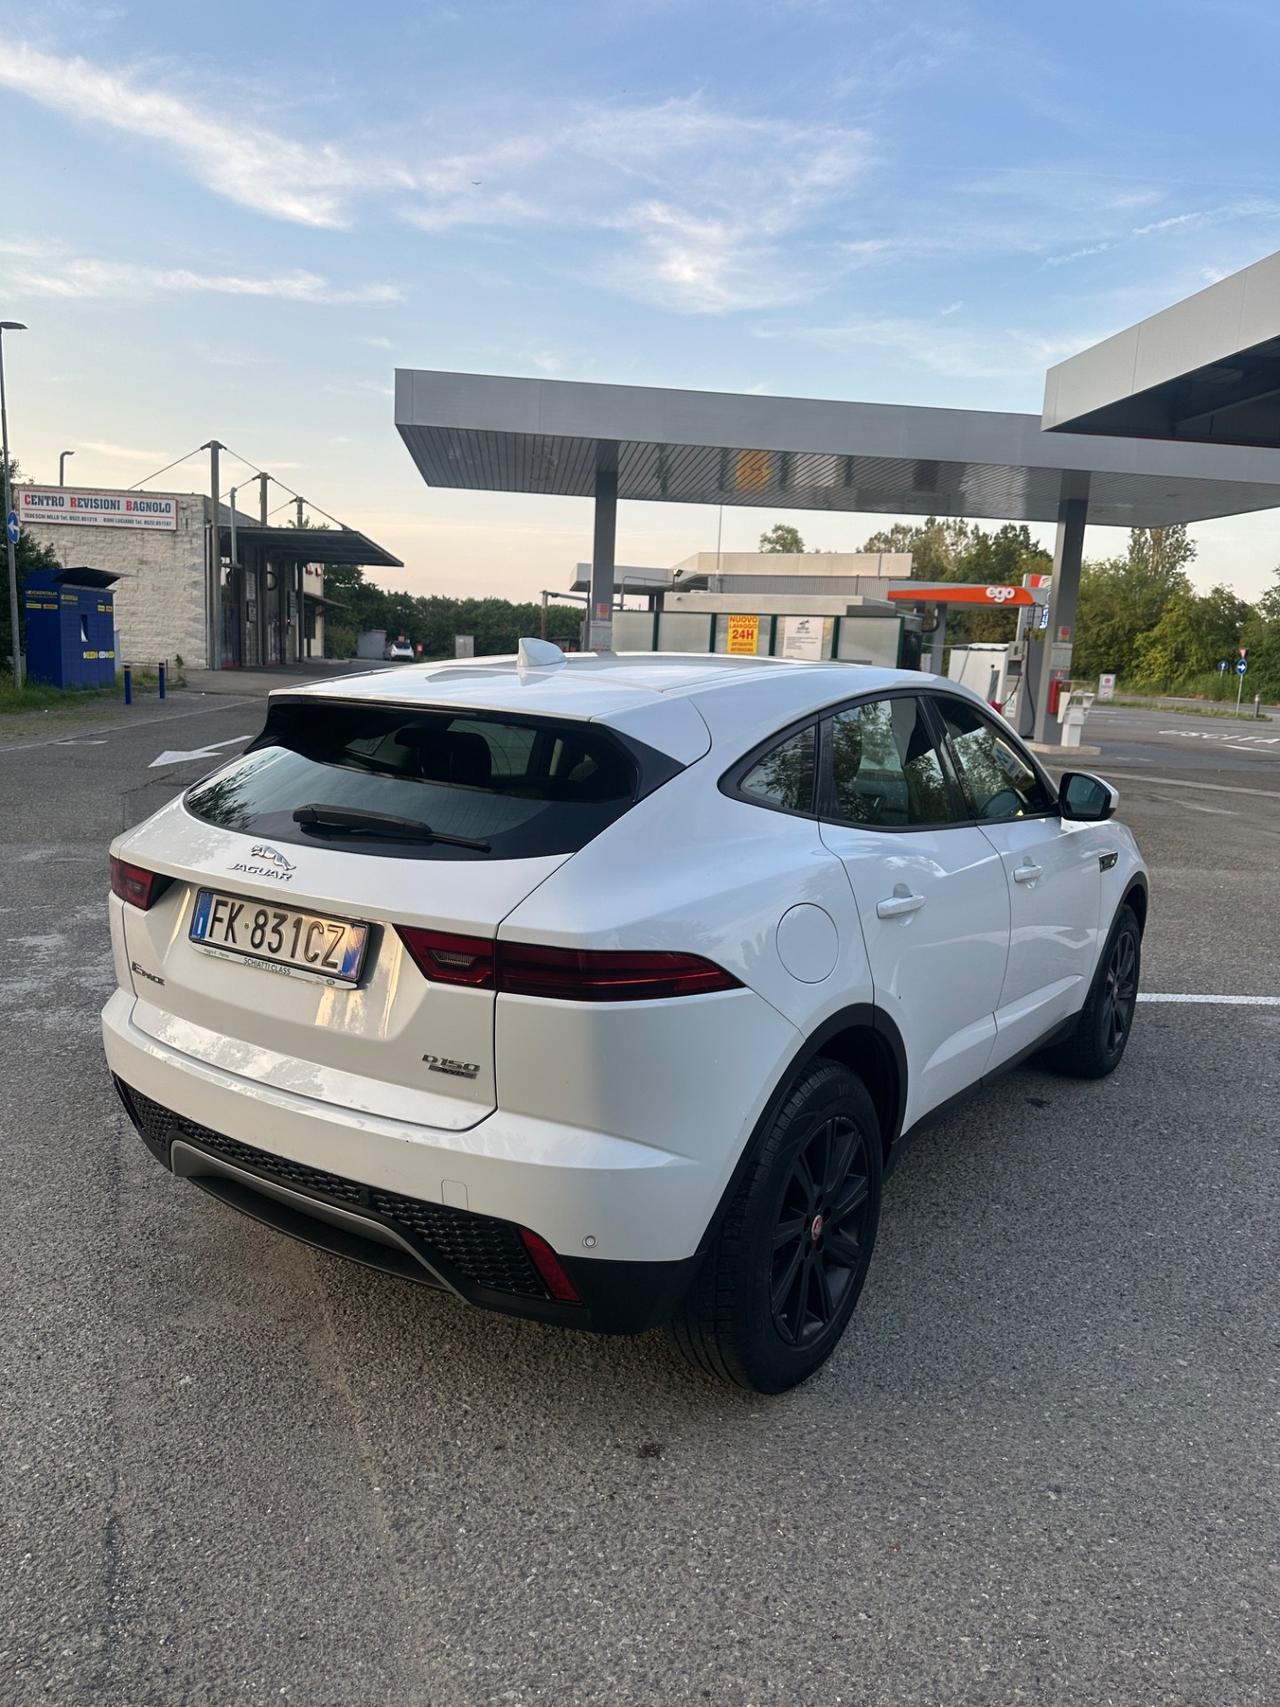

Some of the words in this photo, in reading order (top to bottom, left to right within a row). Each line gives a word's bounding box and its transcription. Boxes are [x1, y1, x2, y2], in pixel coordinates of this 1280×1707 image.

[24, 494, 65, 508] CENTRO
[70, 497, 121, 510] REVISIONI
[126, 500, 172, 513] BAGNOLO
[985, 587, 1015, 603] ego
[732, 629, 754, 640] 24H
[226, 863, 293, 882] JAGUAR
[208, 898, 245, 944] FK
[250, 908, 346, 970] 831CZ
[422, 1054, 480, 1072] D150
